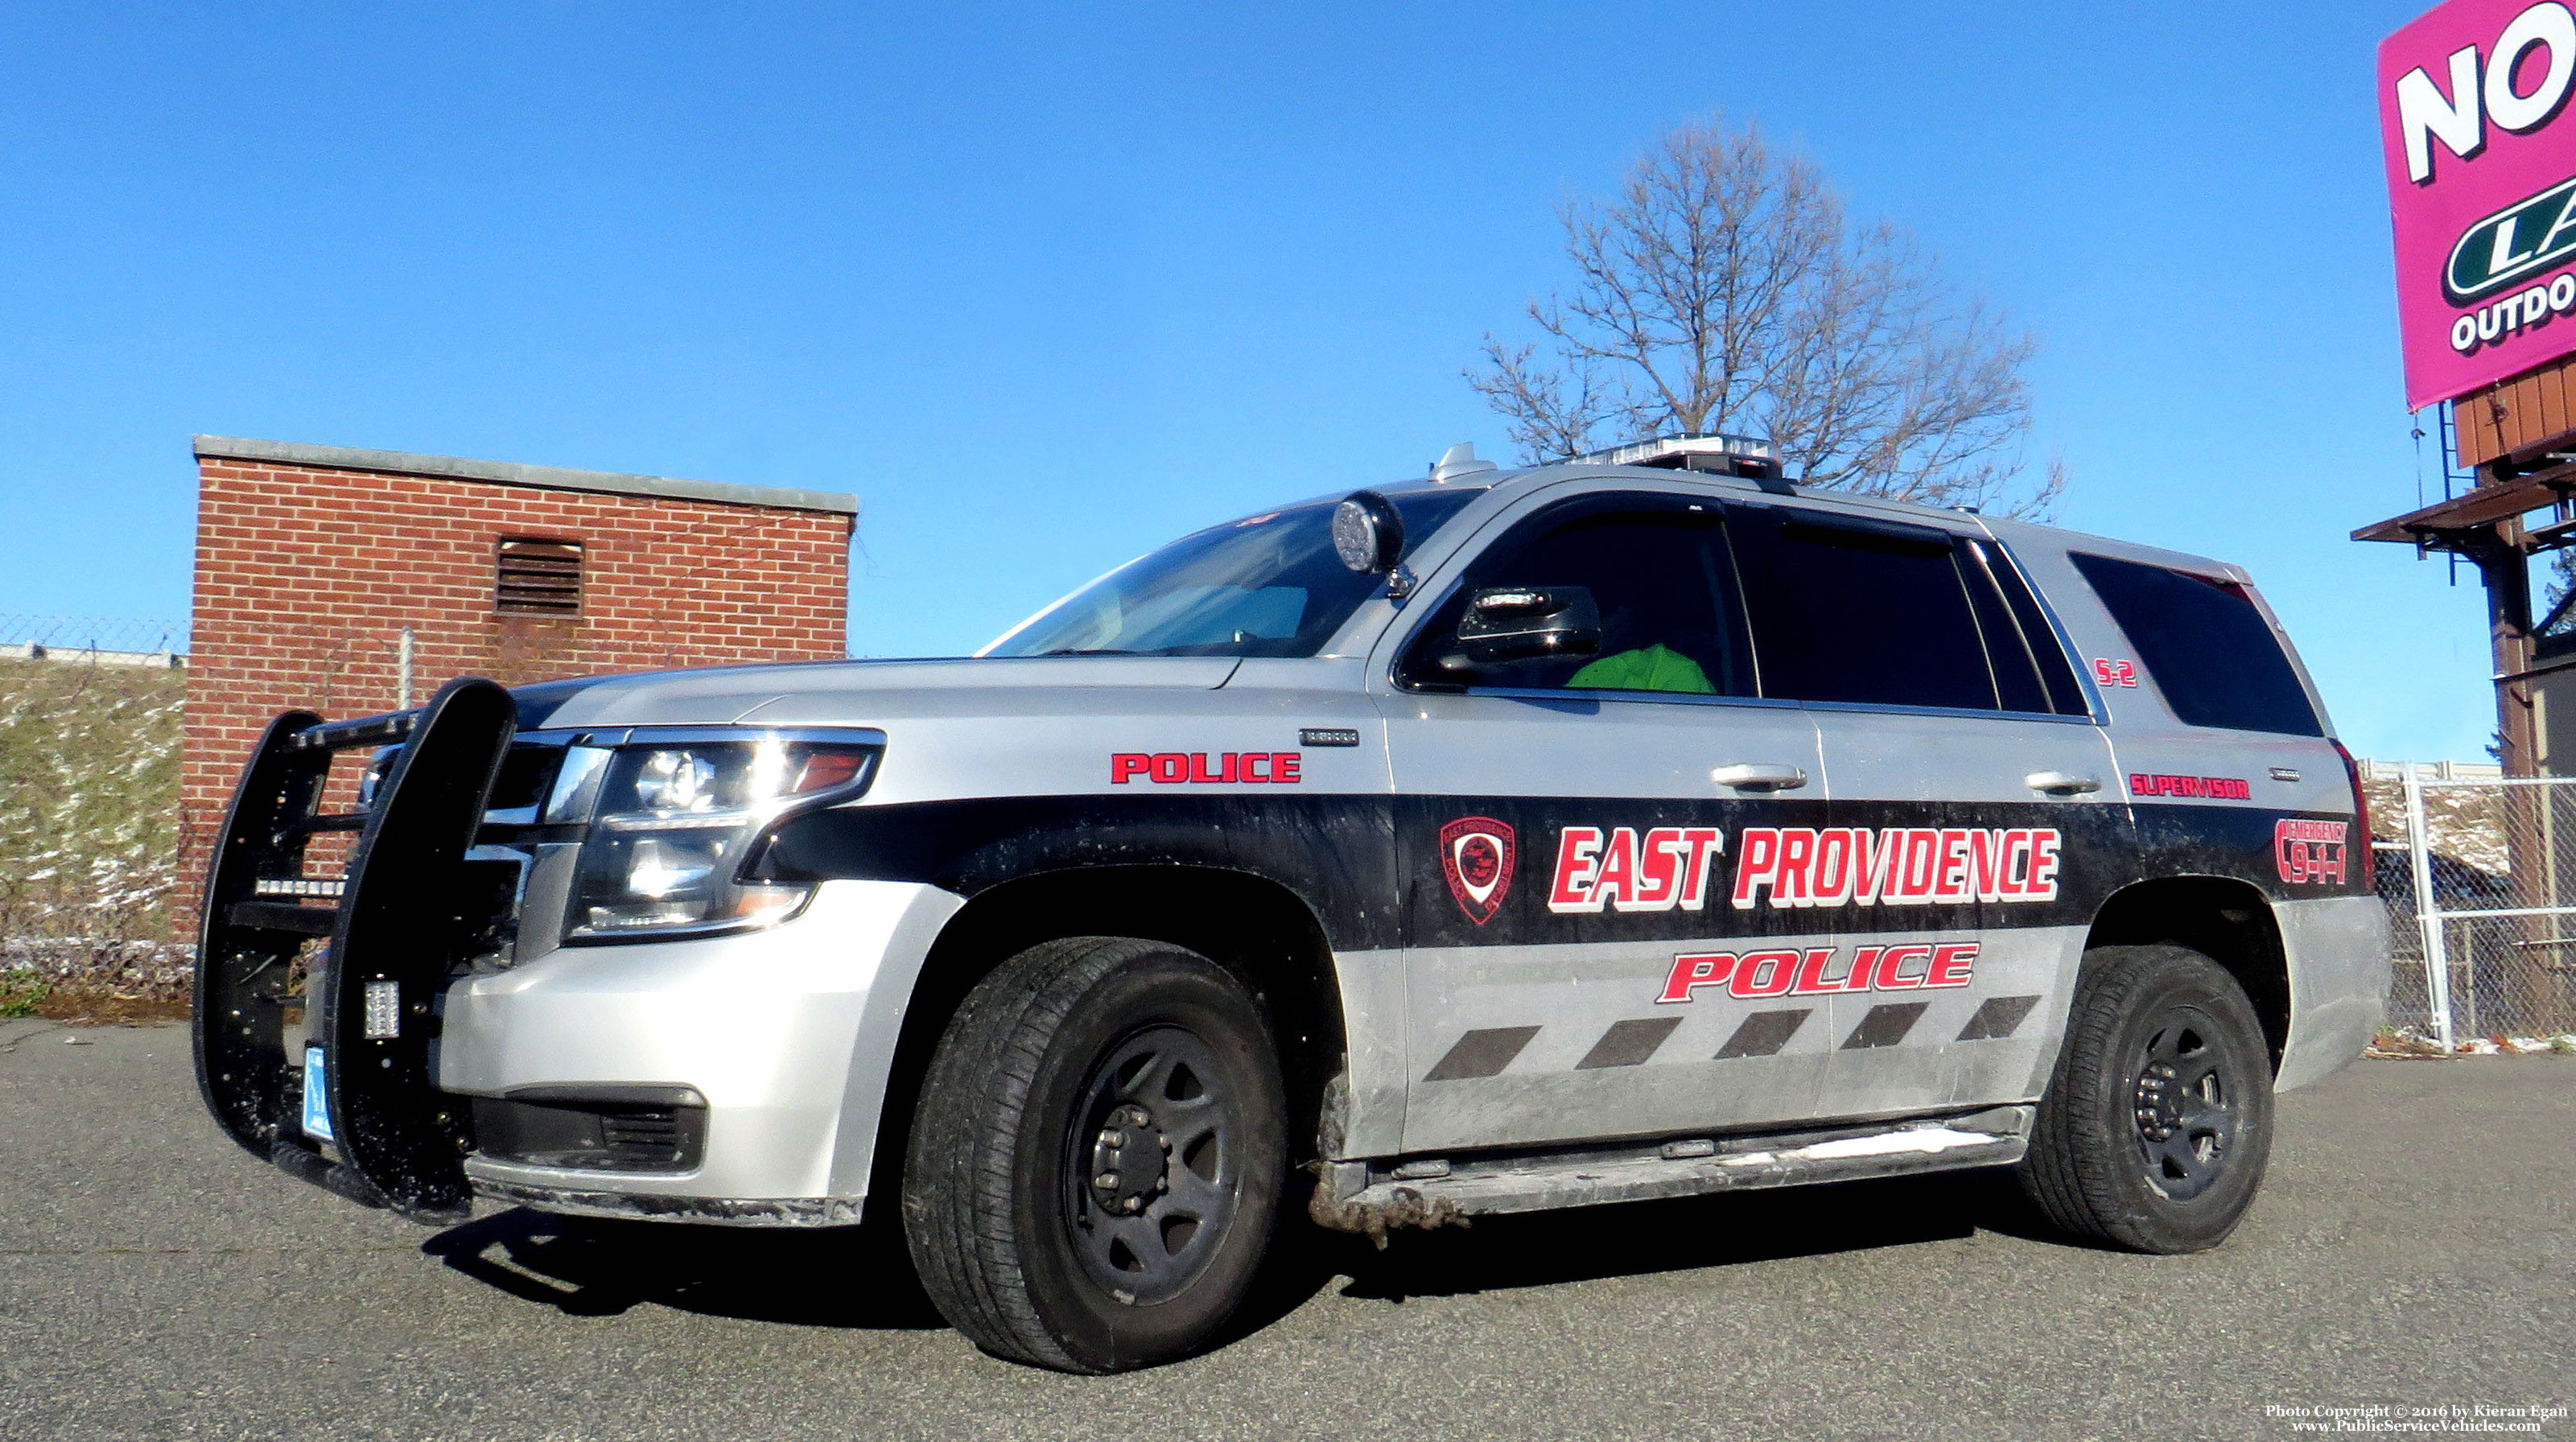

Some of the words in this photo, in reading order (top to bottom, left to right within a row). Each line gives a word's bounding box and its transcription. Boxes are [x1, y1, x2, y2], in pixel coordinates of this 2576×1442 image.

[2396, 1, 2576, 186] NO
[2451, 273, 2576, 352] OUTDO
[2094, 657, 2137, 688] S-2
[1111, 752, 1302, 785] POLICE
[2129, 773, 2251, 801] SUPERVISOR
[1548, 826, 1725, 913] EAST
[1731, 826, 2063, 910] PROVIDENCE
[1655, 941, 1982, 1005] POLICE
